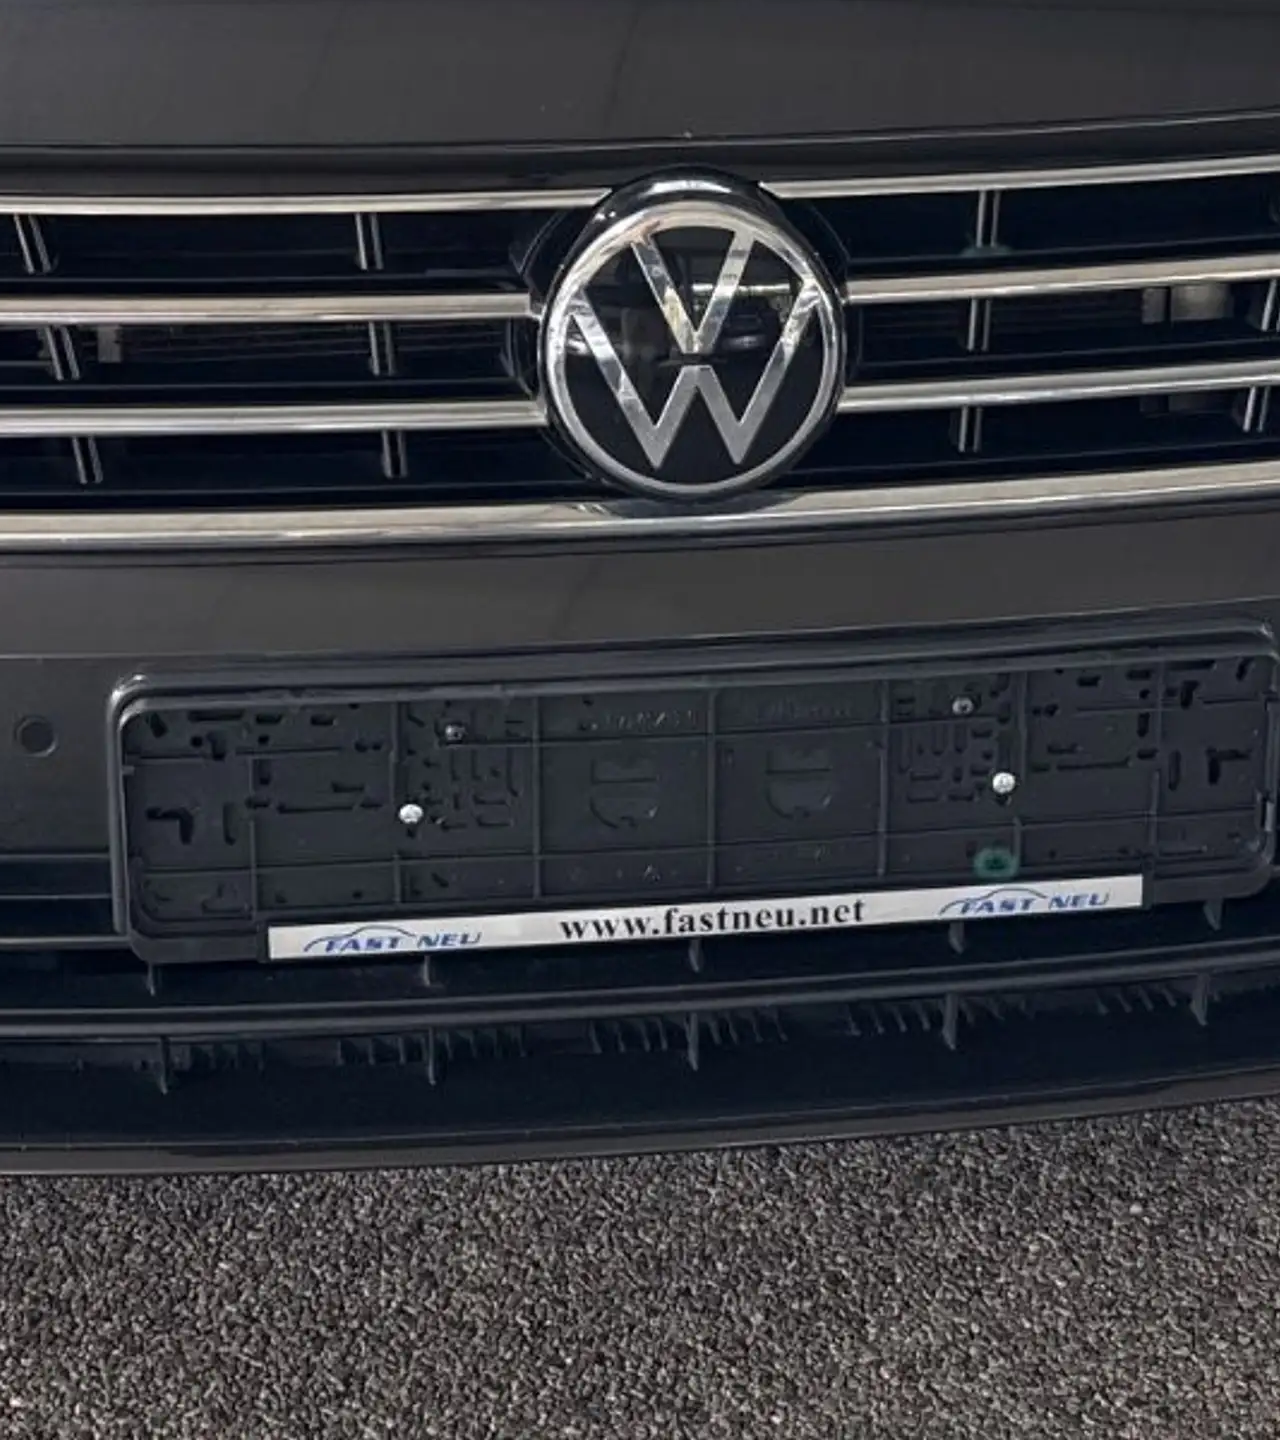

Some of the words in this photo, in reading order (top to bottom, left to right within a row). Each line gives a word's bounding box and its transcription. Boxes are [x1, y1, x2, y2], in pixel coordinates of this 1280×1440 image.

[325, 936, 401, 953] FAST
[417, 931, 483, 948] NEU
[559, 898, 866, 940] www.fastneu.net
[961, 897, 1037, 915] FAST
[1047, 892, 1110, 910] NEU
